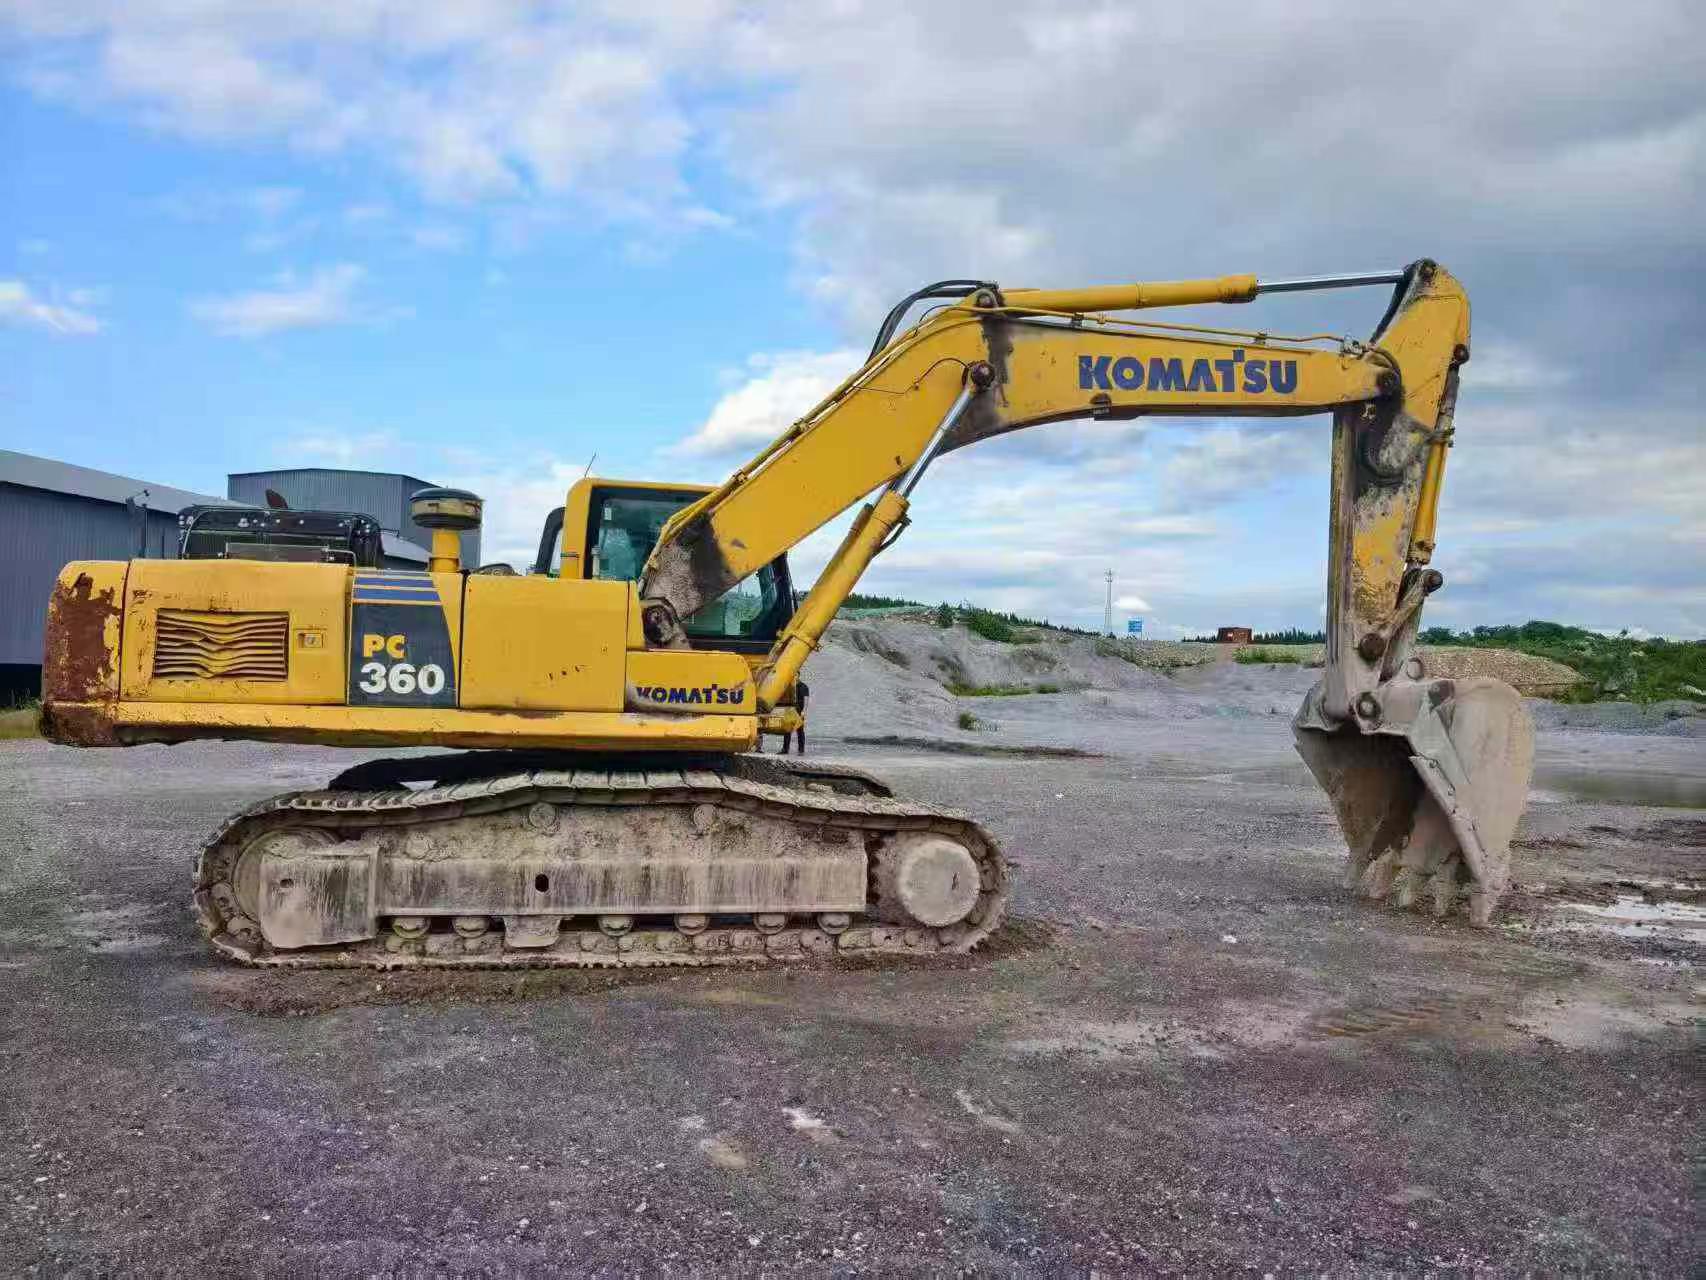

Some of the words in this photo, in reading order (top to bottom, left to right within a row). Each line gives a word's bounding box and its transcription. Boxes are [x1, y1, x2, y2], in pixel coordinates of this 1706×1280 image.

[1078, 349, 1298, 394] KOMATSU
[363, 633, 406, 659] PC
[359, 662, 445, 695] 360
[636, 684, 744, 704] KOMATSU
